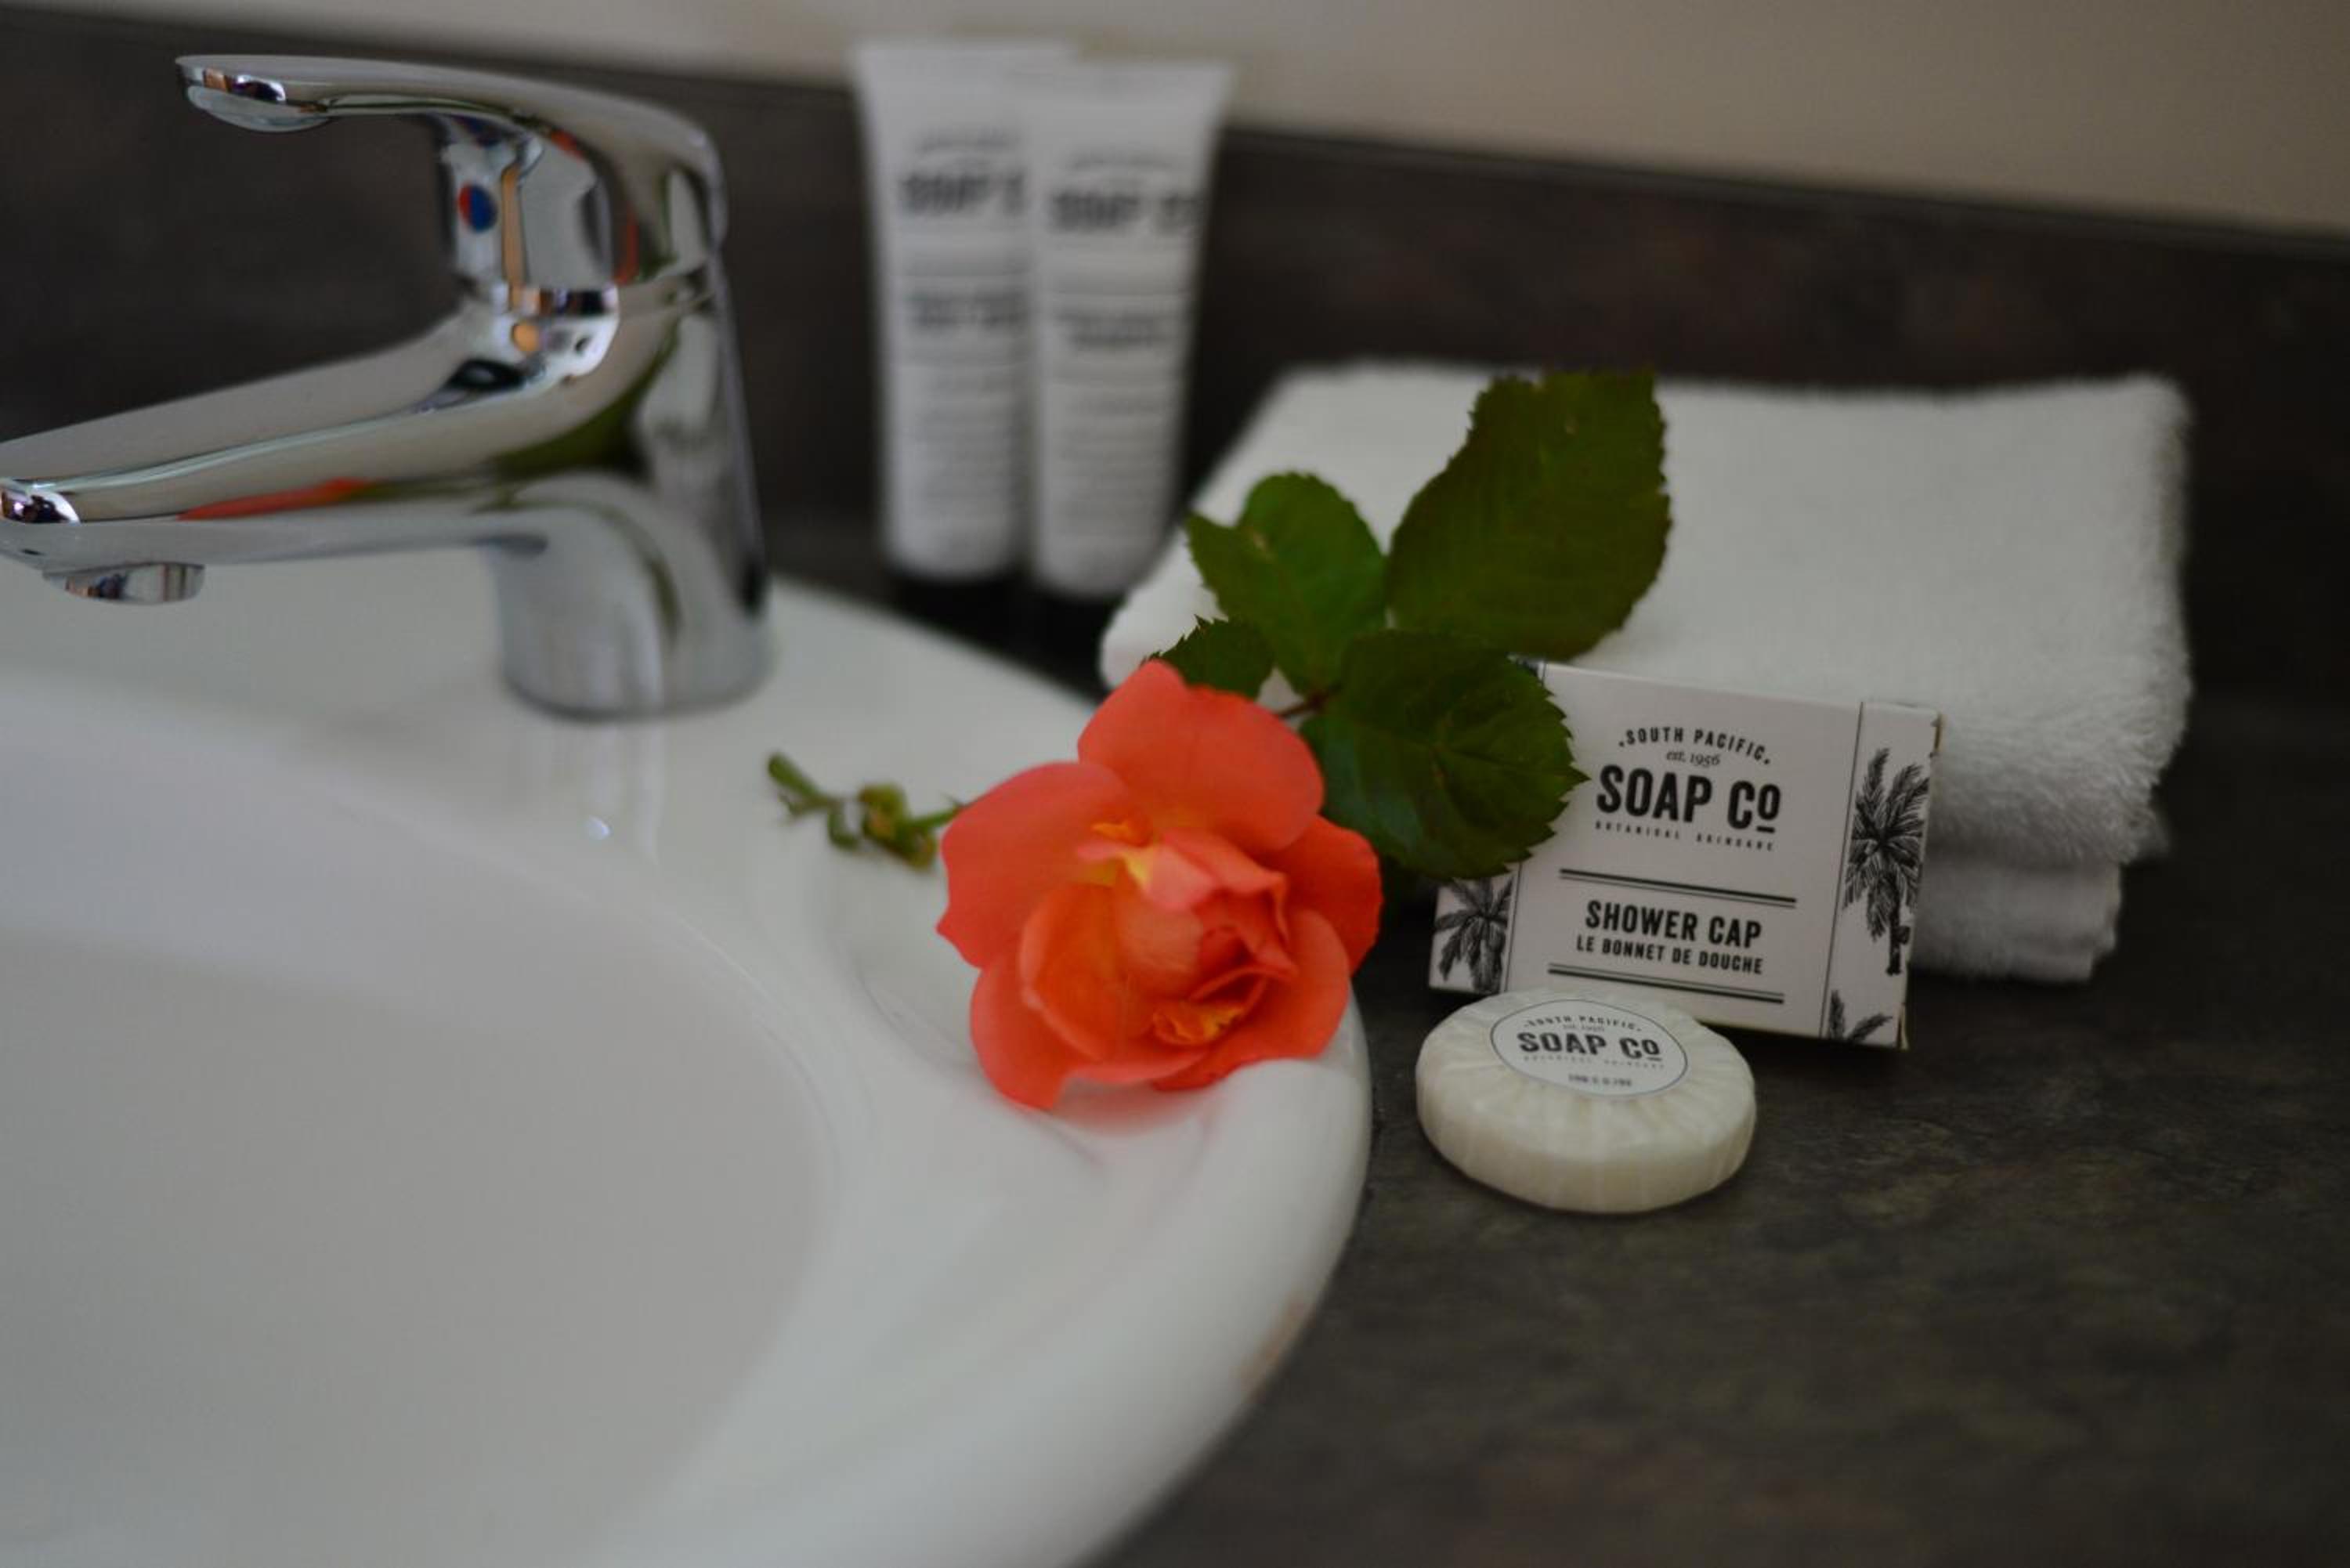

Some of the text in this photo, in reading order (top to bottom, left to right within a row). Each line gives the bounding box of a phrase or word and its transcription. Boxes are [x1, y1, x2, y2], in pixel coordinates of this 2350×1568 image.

[1690, 753, 1721, 768] 1956
[1596, 764, 1712, 823] SOAP
[1585, 900, 1762, 949] SHOWER CAP
[1576, 934, 1763, 975] LE BONNET DE DOUCHE
[1517, 1031, 1607, 1055] SOAP
